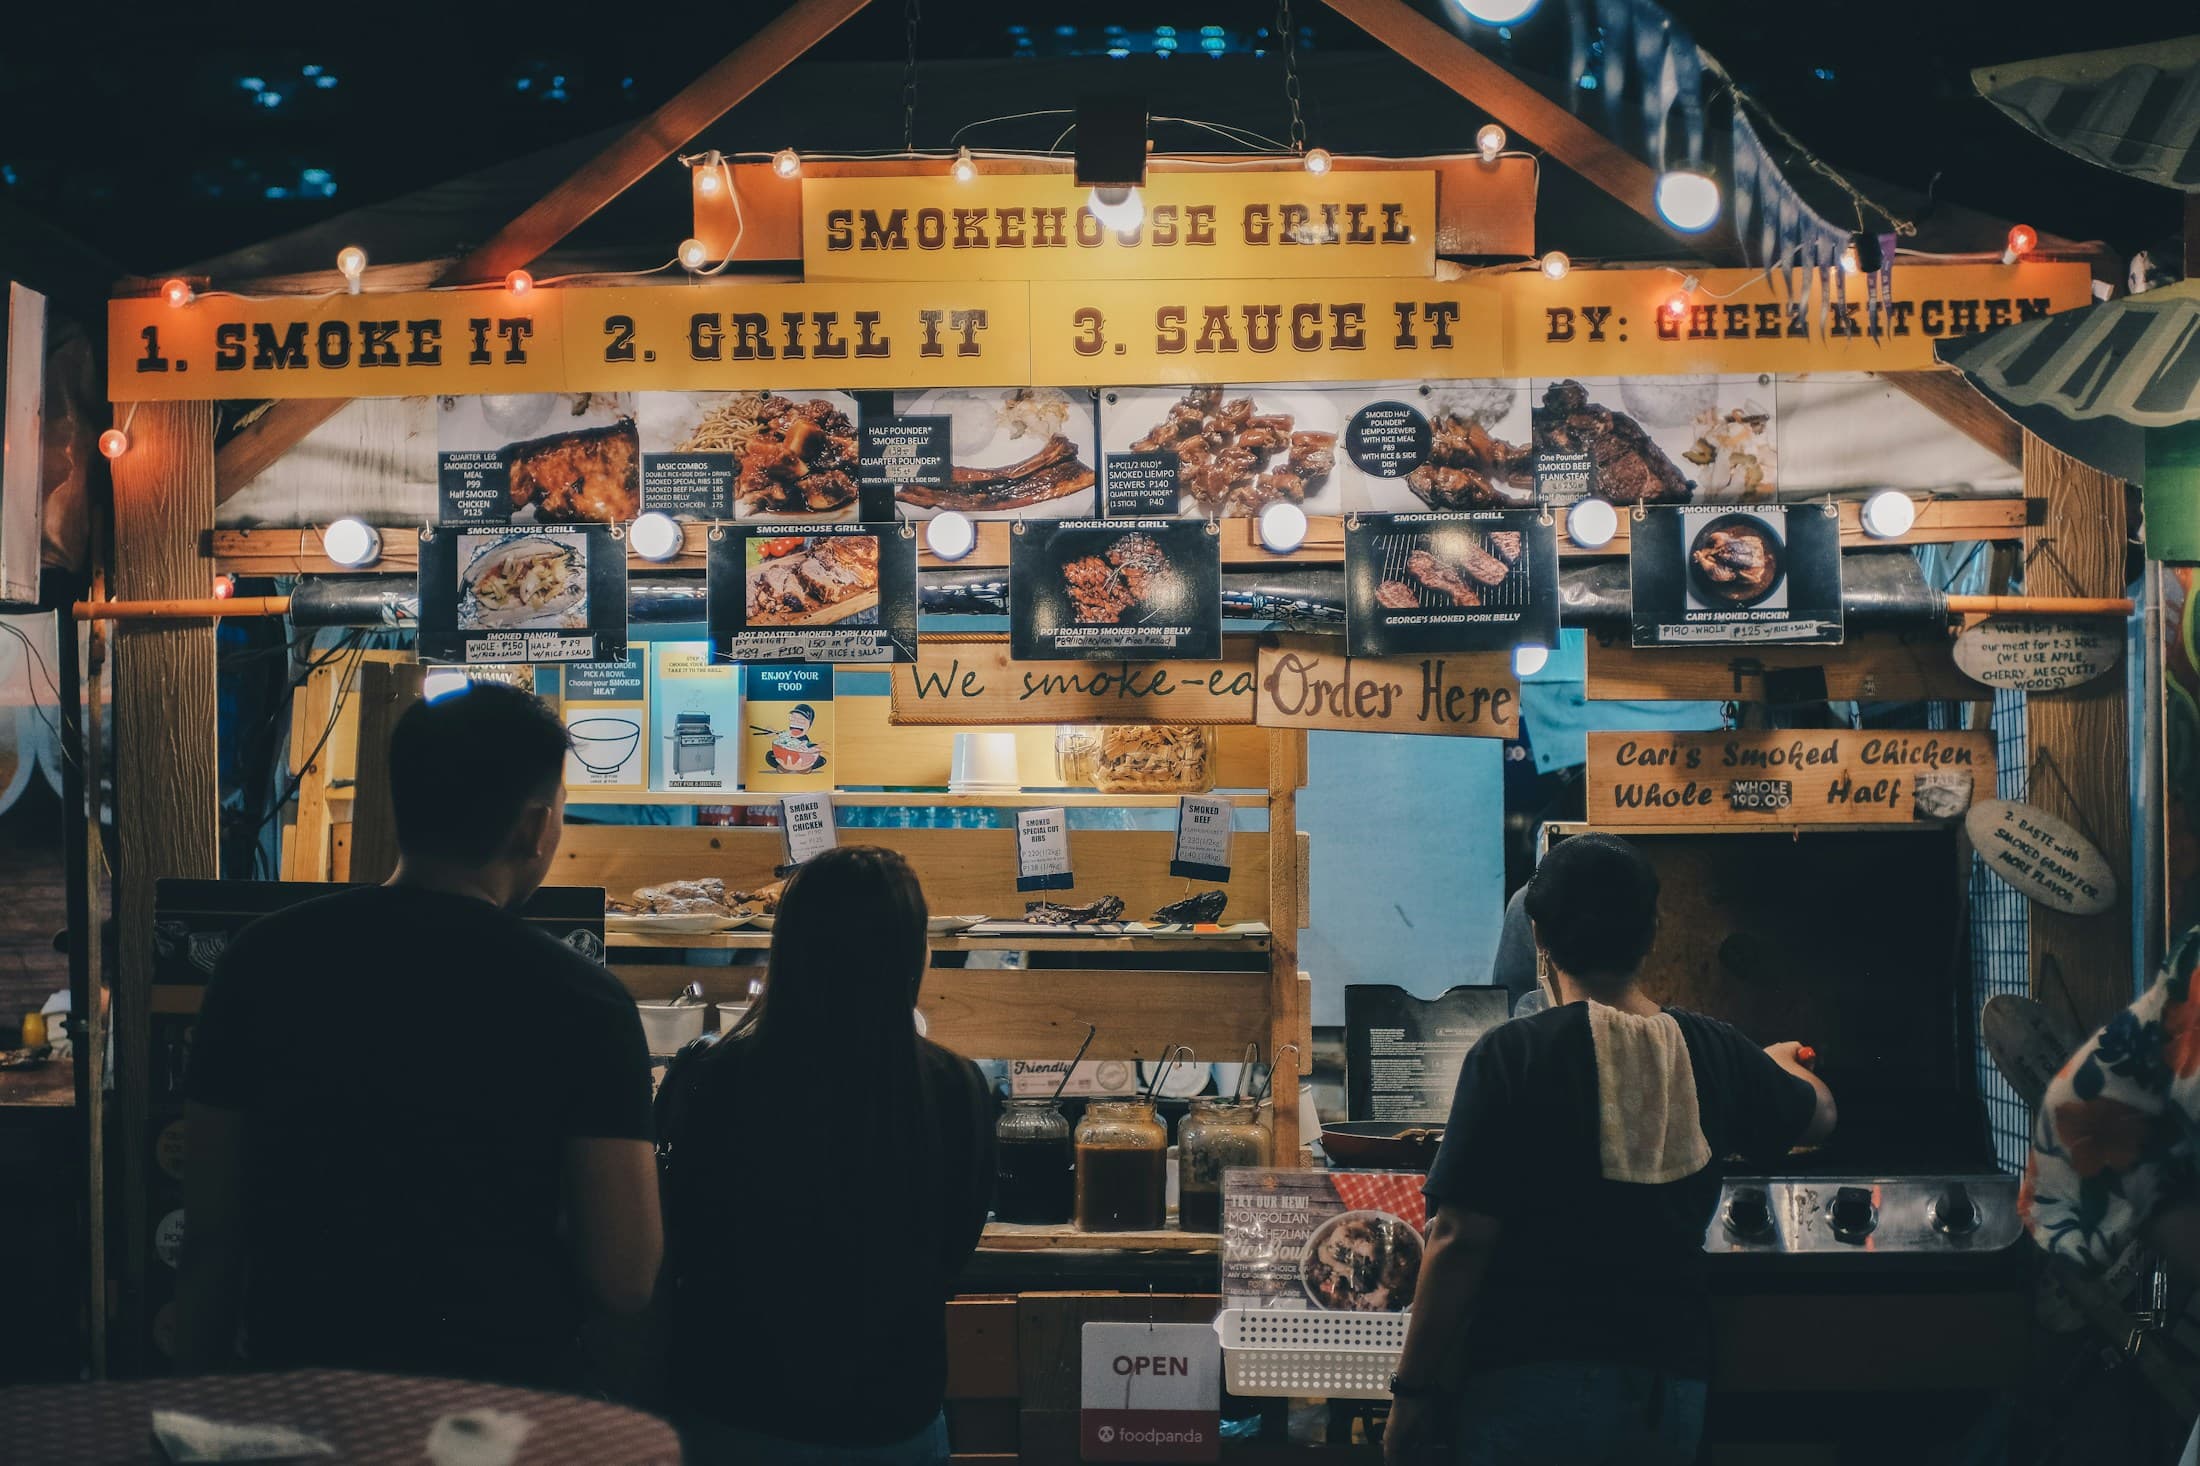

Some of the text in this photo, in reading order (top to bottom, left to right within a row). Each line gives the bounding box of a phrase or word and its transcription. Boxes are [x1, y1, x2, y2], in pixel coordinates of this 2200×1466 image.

[1242, 203, 1413, 247] GRILL
[1546, 306, 1629, 343] BY:
[1830, 297, 2052, 338] KITCHEN
[1073, 301, 1460, 356] 3. SAUCE IT
[604, 309, 989, 362] 2. GRILL IT
[136, 318, 534, 373] 1. SMOKE IT
[868, 427, 889, 435] HALF
[872, 437, 929, 446] SMOKED BELLY
[1362, 436, 1380, 444] WITH
[474, 462, 502, 470] CHICKEN
[861, 457, 896, 466] QUARTER
[1537, 462, 1591, 472] SMOKED BEEF
[1109, 470, 1174, 479] SMOKED LIEMPO
[1541, 472, 1590, 481] FLANK STEAK
[467, 480, 481, 488] P99
[1109, 480, 1169, 489] SKEWERS P140
[465, 490, 498, 498] SMOKED
[1679, 504, 1789, 514] SMOKEHOUSE GRILL
[1394, 512, 1504, 522] SMOKEHOUSE GRILL
[756, 524, 866, 534] SMOKEHOUSE GRILL
[1059, 520, 1169, 529] SMOKEHOUSE GRILL
[467, 525, 576, 535] SMOKEHOUSE GRILL
[1385, 613, 1521, 625] GEORGE'S SMOKED PORK BELLY
[1713, 612, 1749, 621] SMOKED
[1749, 611, 1790, 620] CHICKEN
[487, 632, 559, 641] SMOKED BANGUS
[859, 629, 888, 638] KASIM
[1040, 627, 1191, 636] POT ROASTED SMOKED PORK BELLY
[2031, 640, 2050, 649] for
[2024, 653, 2046, 663] USE
[583, 670, 626, 678] PICK A BOWL
[761, 671, 819, 681] ENJOY YOUR
[568, 679, 592, 687] Choose
[609, 679, 641, 687] SMOKED
[912, 660, 985, 699] We
[778, 682, 803, 691] FOOD
[1265, 653, 1513, 724] Order Here
[1722, 740, 1839, 772] Smoked
[1861, 738, 1973, 768] Chicken
[1614, 778, 1902, 810] Whole WHOLE Half
[1730, 793, 1791, 809] 190.00
[789, 802, 819, 813] SMOKED
[1189, 805, 1219, 815] SMOKED
[1026, 818, 1050, 827] SMOKED
[1194, 815, 1211, 824] BEEF
[792, 820, 823, 832] CHICKEN
[2004, 811, 2014, 822] 2.
[2018, 819, 2055, 847] BASTE
[1023, 828, 1046, 836] SPECIAL
[1031, 835, 1046, 843] RIBS
[1994, 828, 2099, 899] SMOKED GRAVY FOR
[1998, 851, 2075, 904] MORE FLAVOR
[1014, 1061, 1072, 1077] Friendly
[1230, 1195, 1309, 1208] TRY OUR NEW!
[1229, 1211, 1309, 1224] MONGOLIAN
[1112, 1355, 1188, 1376] OPEN
[1119, 1428, 1202, 1446] foodpanda
